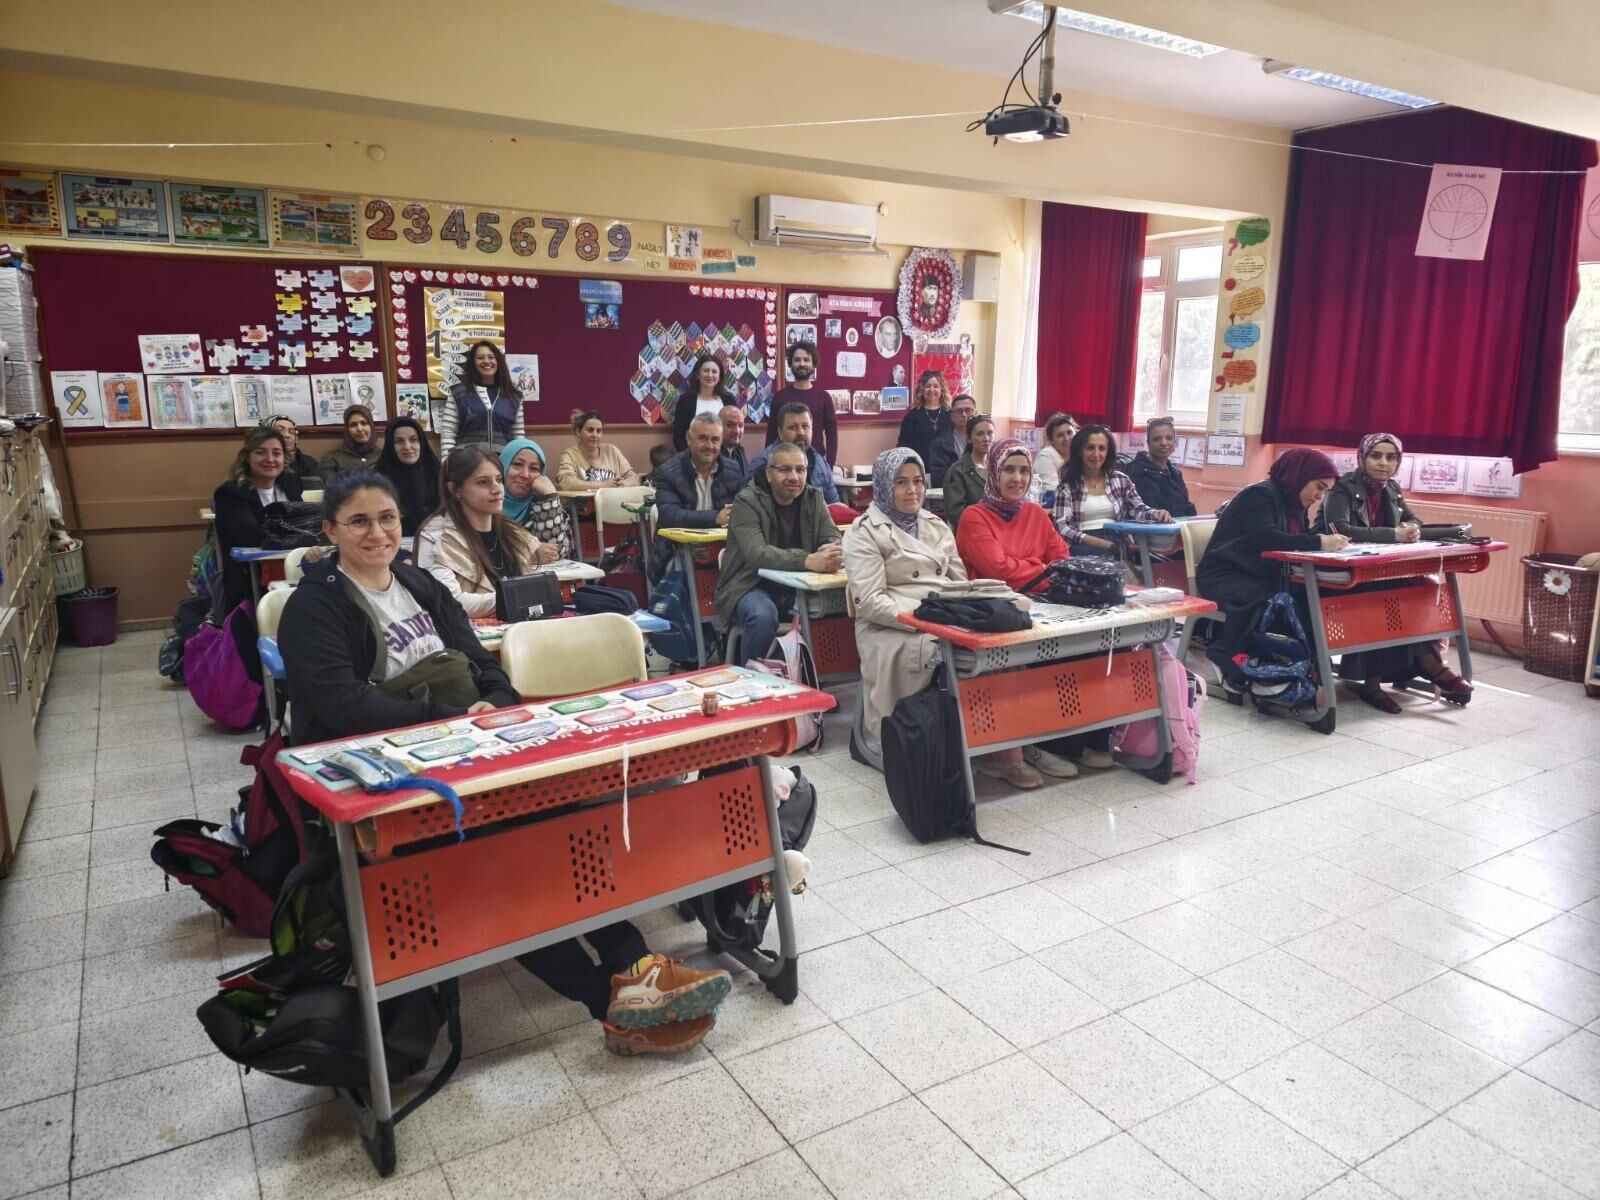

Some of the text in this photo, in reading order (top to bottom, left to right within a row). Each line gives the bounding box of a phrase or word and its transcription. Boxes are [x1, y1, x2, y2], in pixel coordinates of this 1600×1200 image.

[365, 200, 631, 261] 2 3 4 5 6 7 8 9
[646, 261, 661, 269] NE?
[431, 293, 446, 304] Gün
[435, 304, 452, 317] Saat
[445, 317, 455, 326] Ay
[451, 331, 461, 339] Ay
[427, 330, 441, 358] 1
